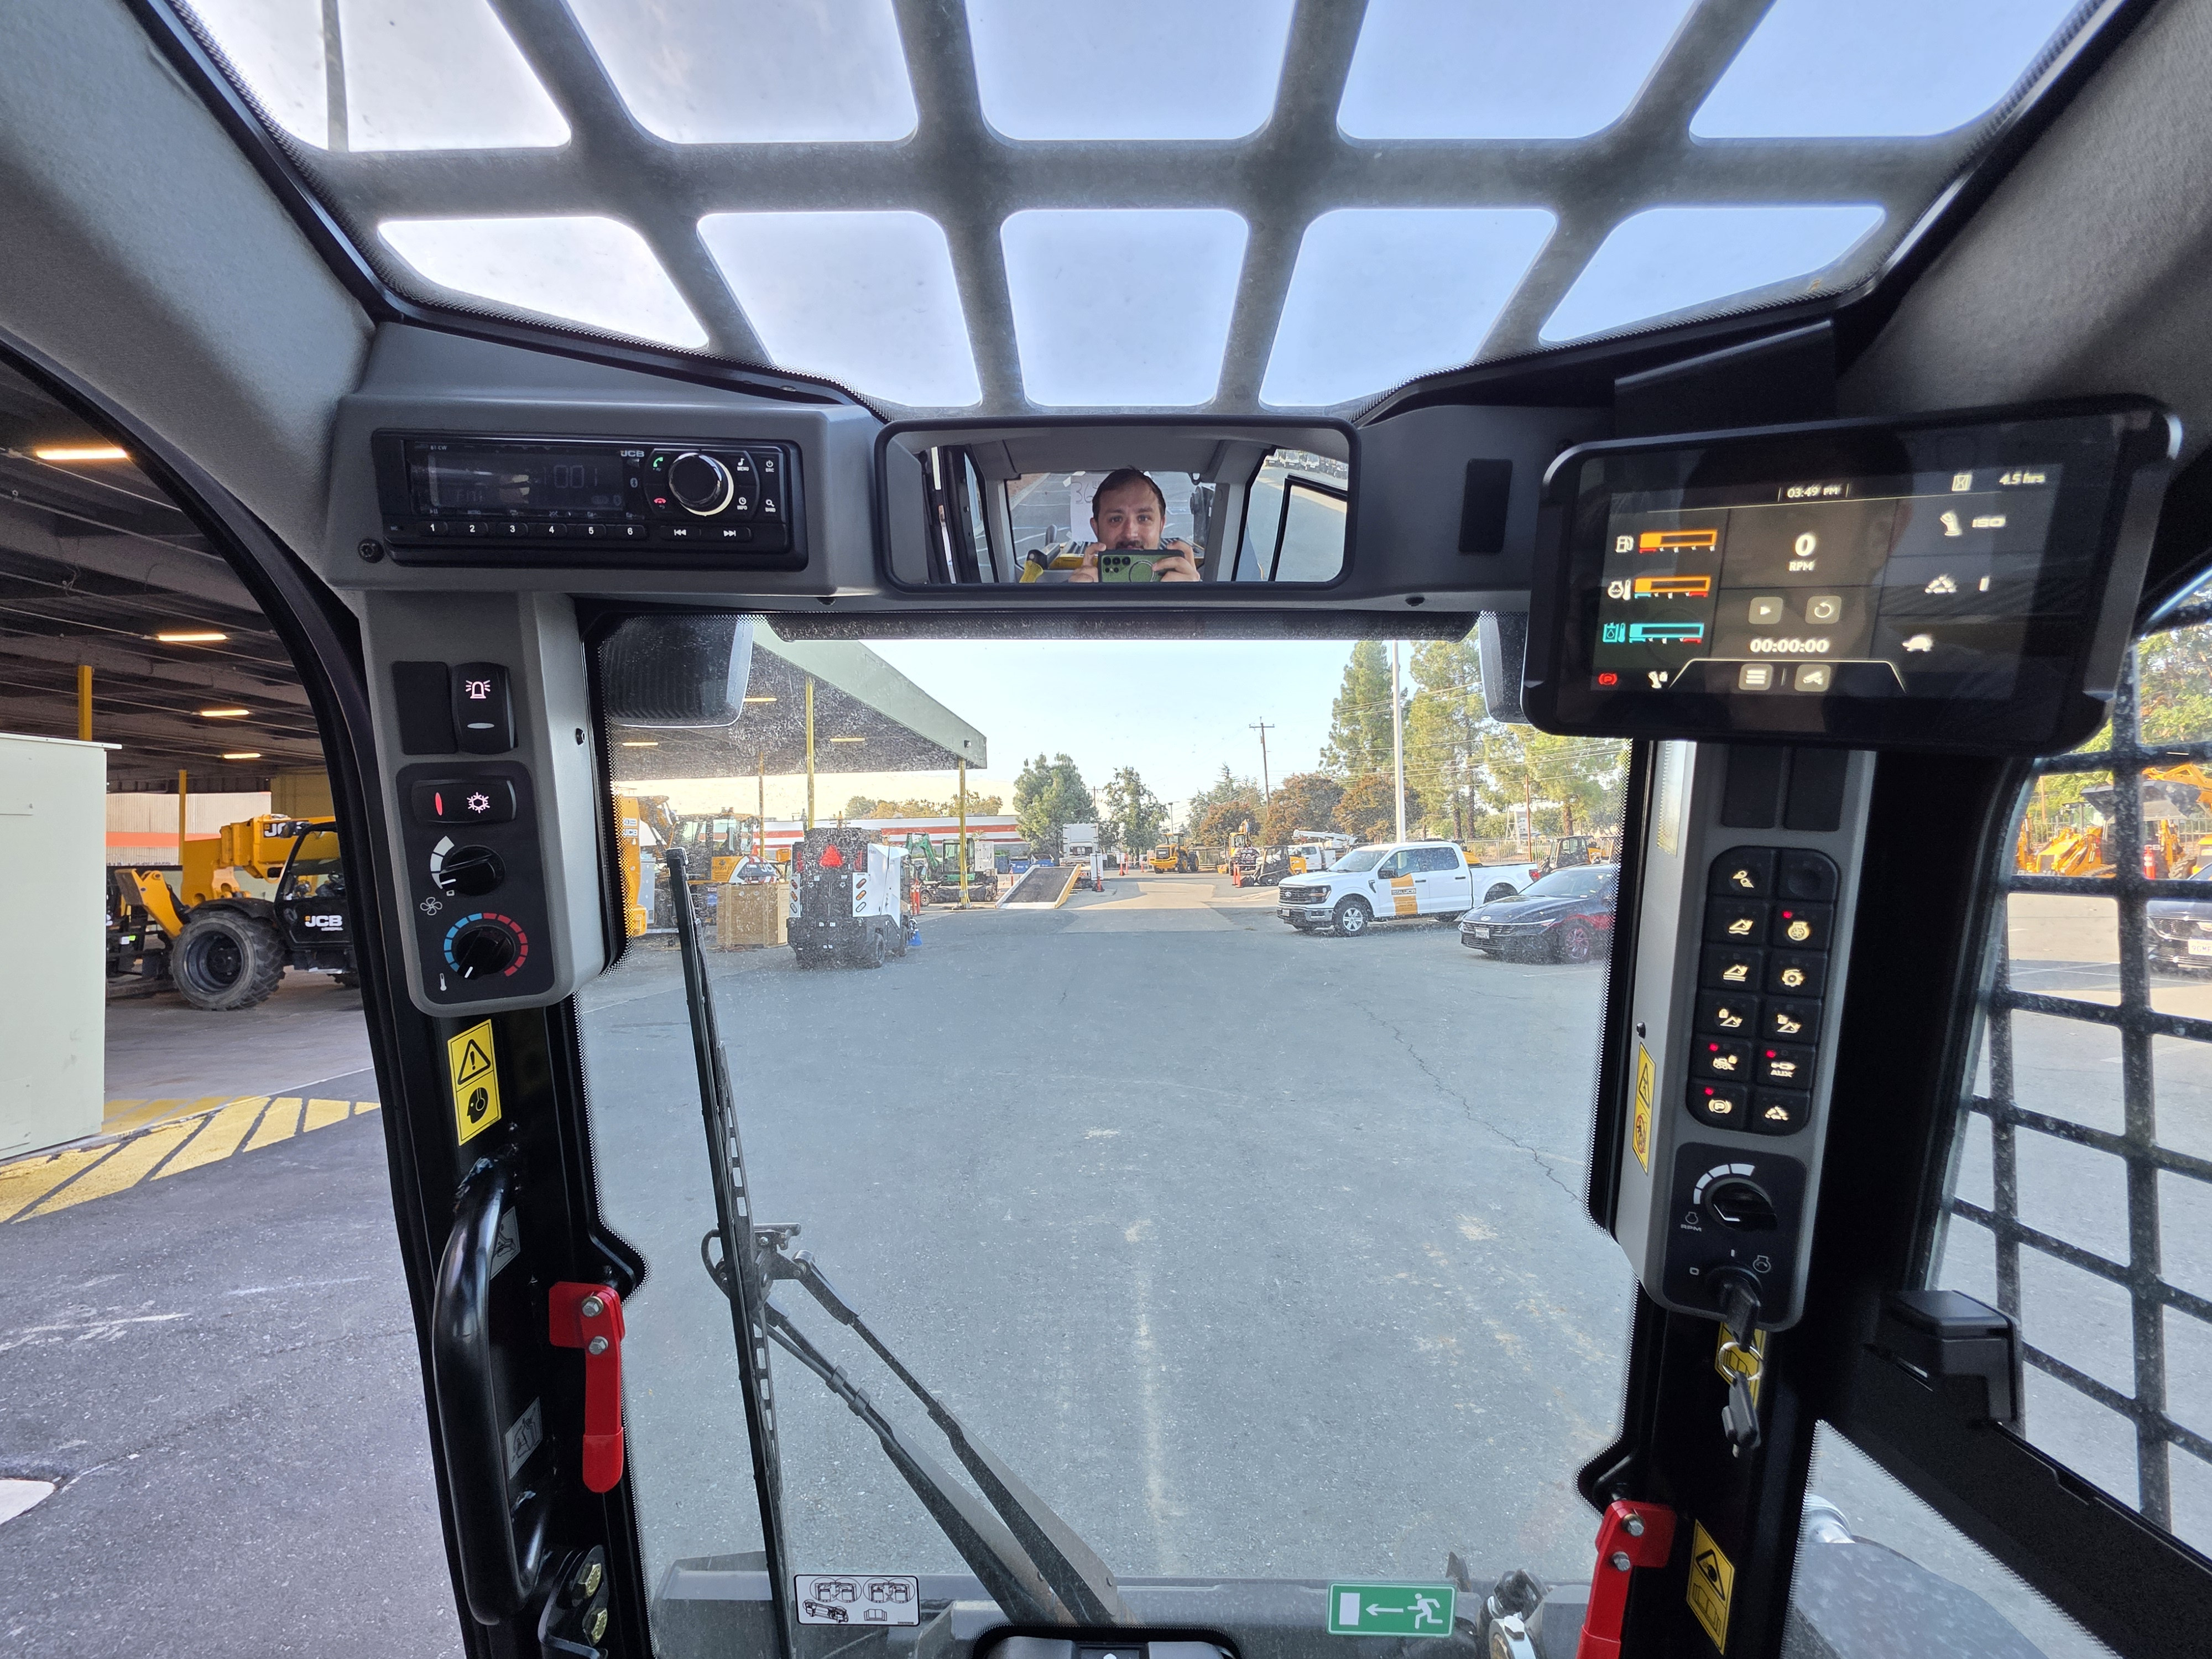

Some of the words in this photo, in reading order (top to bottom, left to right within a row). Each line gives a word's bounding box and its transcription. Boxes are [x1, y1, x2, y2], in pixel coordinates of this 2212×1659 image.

[2023, 472, 2045, 484] hrs
[1787, 486, 1819, 498] 03:49
[1823, 486, 1839, 495] PM
[1972, 518, 2006, 528] ISO
[549, 525, 554, 534] 4
[1795, 534, 1816, 556] 0
[1788, 560, 1814, 571] RPM
[1750, 639, 1829, 653] 00:00:00
[305, 915, 342, 927] JCB
[1770, 1070, 1793, 1078] AUX
[1681, 1224, 1702, 1232] RPM
